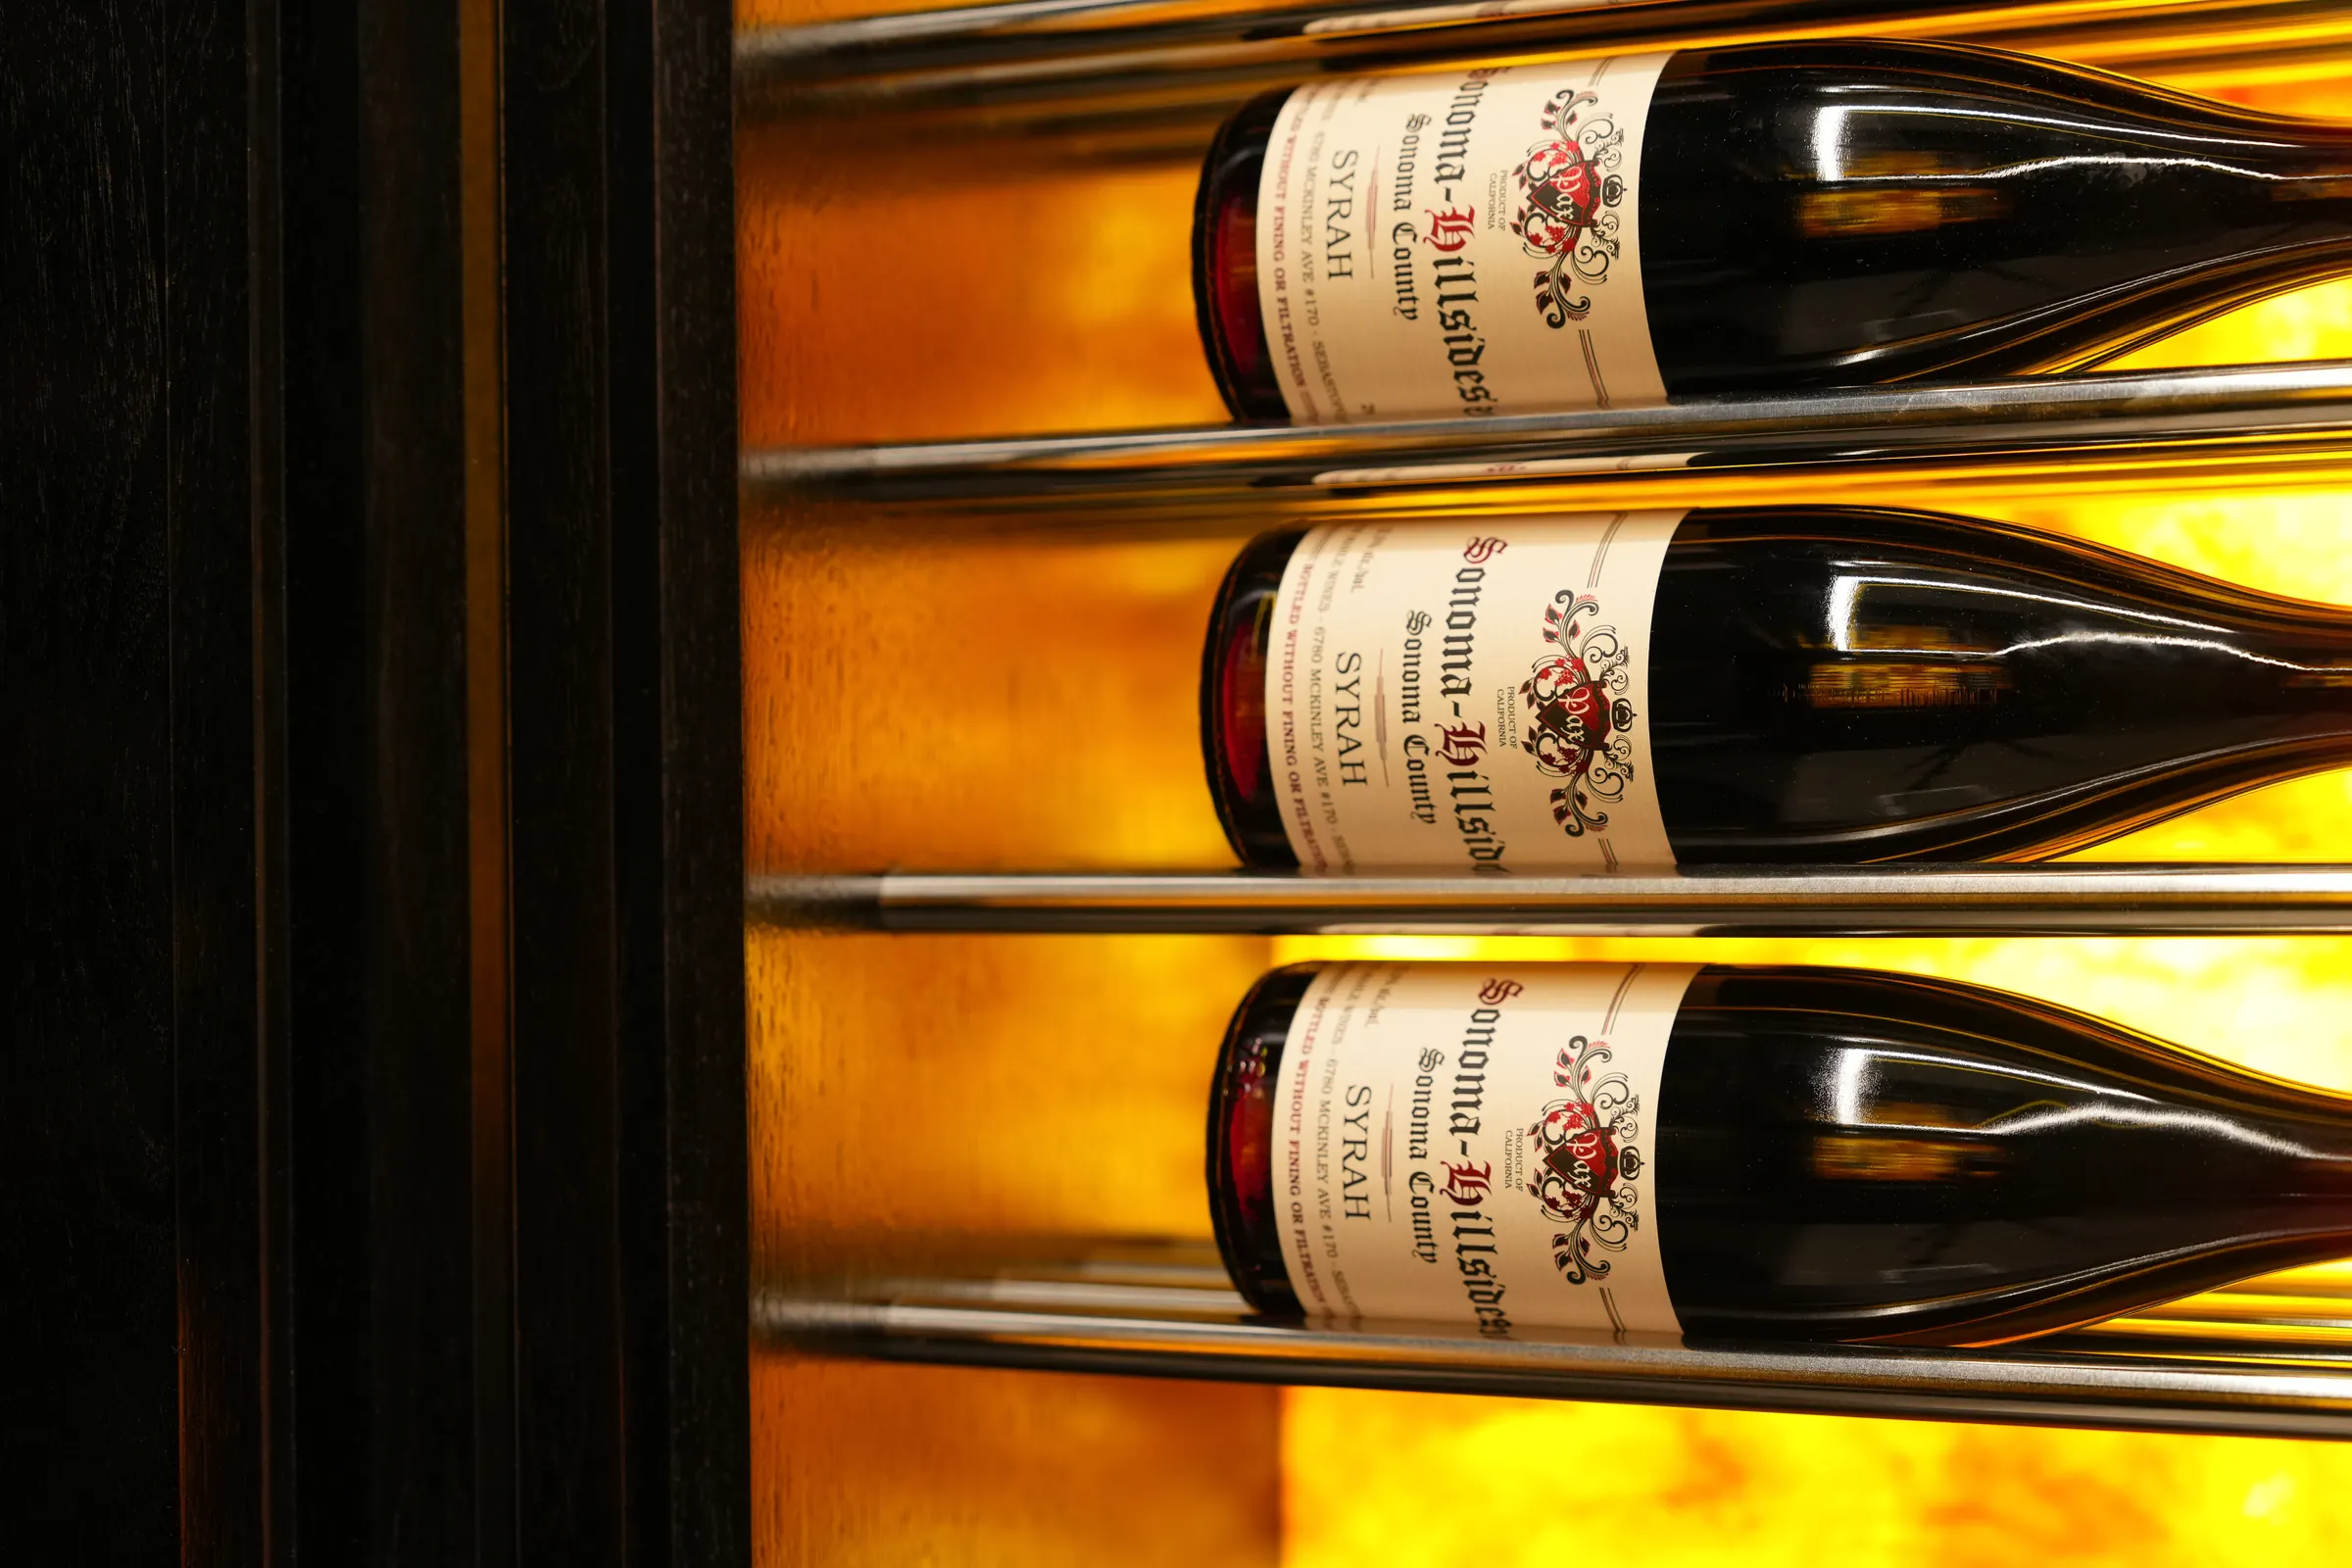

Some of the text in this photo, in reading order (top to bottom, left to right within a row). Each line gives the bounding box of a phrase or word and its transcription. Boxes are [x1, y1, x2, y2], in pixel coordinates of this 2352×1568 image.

[1276, 135, 1297, 199] WITHOUT
[1548, 166, 1582, 220] Pax
[1301, 166, 1318, 245] MCKINLEY
[1327, 150, 1358, 279] SYRAH
[1393, 114, 1432, 320] Sonoma County
[1488, 172, 1497, 229] CALIFORNIA
[1497, 170, 1507, 231] PRODUCT OF
[1274, 206, 1286, 261] FINING
[1274, 268, 1286, 291] OR
[1301, 251, 1314, 282] AVE
[1304, 288, 1319, 326] #170
[1277, 297, 1306, 388] FILTRATION
[1290, 564, 1314, 624] BOTTLED
[1282, 629, 1298, 705] WITHOUT
[1311, 626, 1325, 662] 6780
[1283, 711, 1297, 765] FINING
[1309, 668, 1323, 752] MCKINLEY
[1336, 653, 1368, 786] SYRAH
[1401, 610, 1438, 825] Sonoma County
[1497, 689, 1506, 747] CALIFORNIA
[1507, 686, 1517, 749] PRODUCT OF
[1558, 687, 1590, 743] Pax
[1288, 772, 1301, 793] OR
[1313, 757, 1329, 786] AVE
[1321, 792, 1337, 825] #170
[1289, 1058, 1309, 1135] WITHOUT
[1321, 1058, 1338, 1095] 6780
[1289, 1140, 1300, 1196] FINING
[1317, 1100, 1331, 1184] MCKINLEY
[1343, 1085, 1372, 1221] SYRAH
[1409, 1048, 1445, 1263] Sonoma County
[1565, 1133, 1597, 1188] Pax
[1291, 1201, 1303, 1224] OR
[1317, 1188, 1331, 1219] AVE
[1515, 1178, 1523, 1192] OF
[1322, 1224, 1338, 1258] #170
